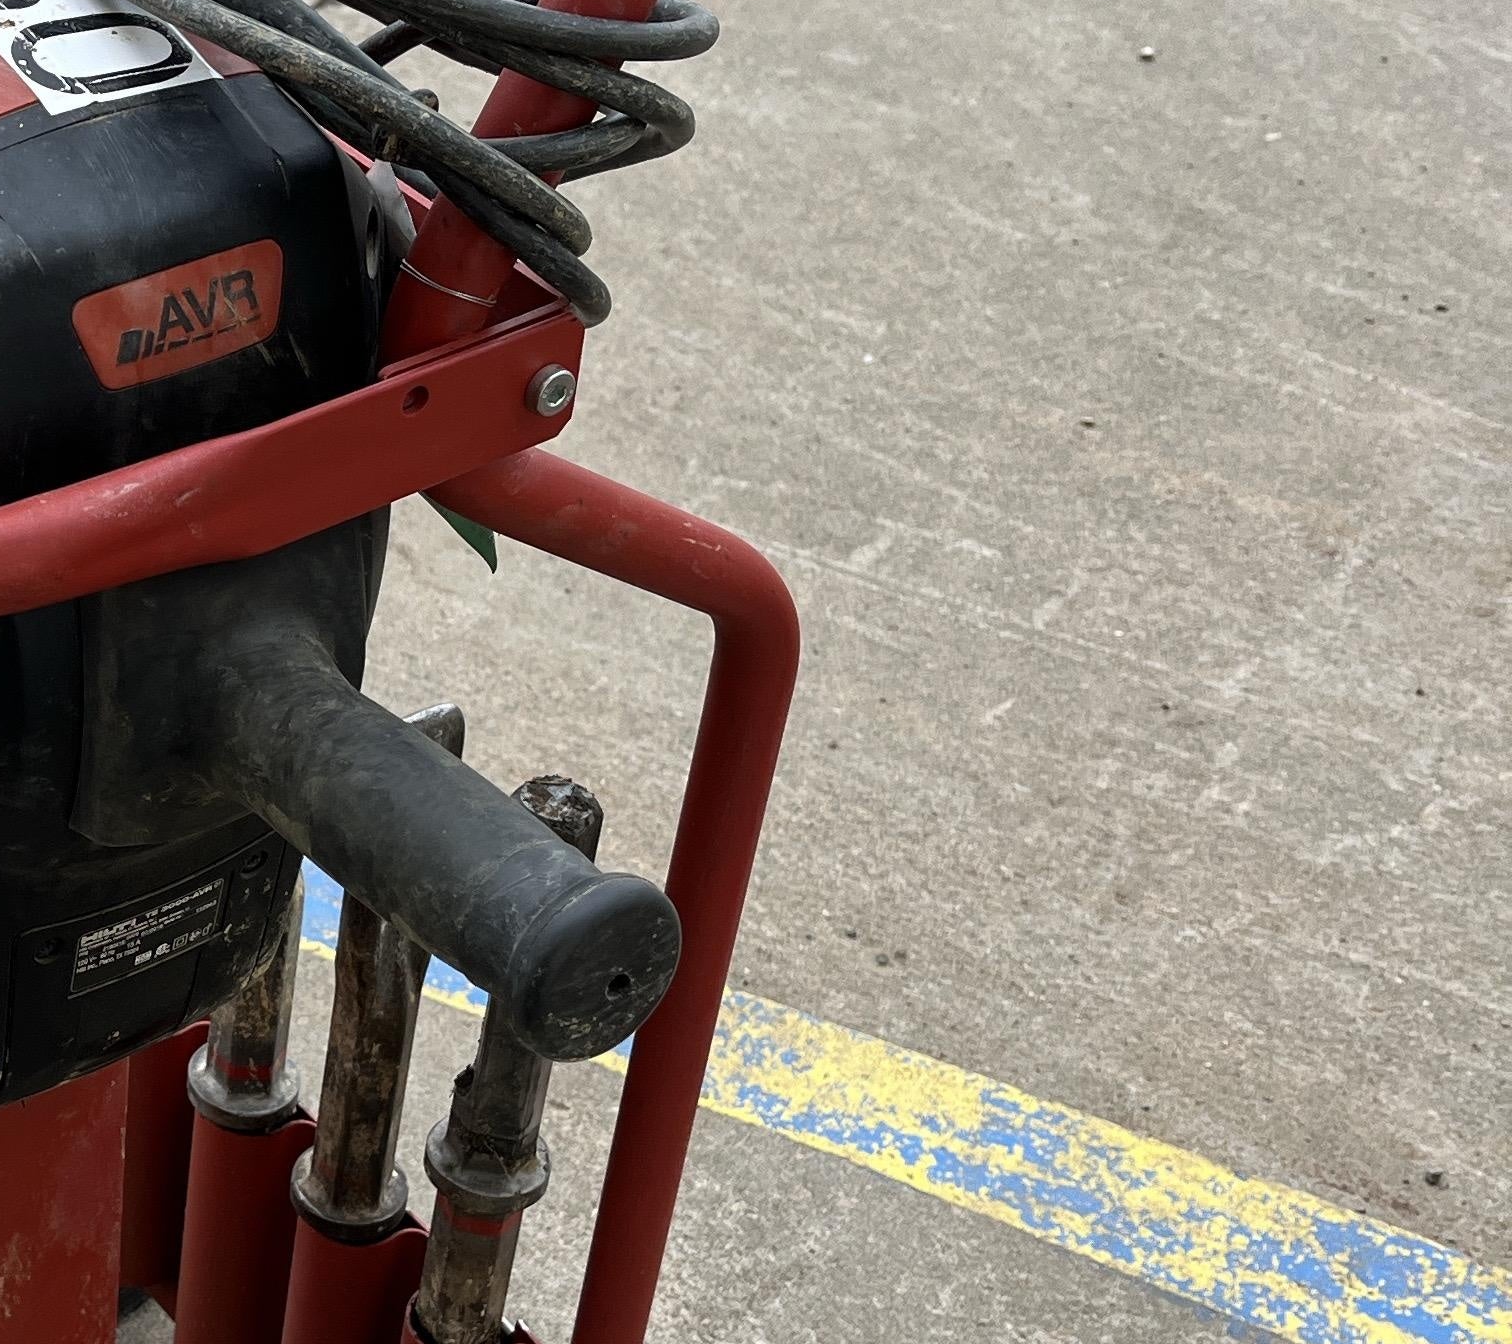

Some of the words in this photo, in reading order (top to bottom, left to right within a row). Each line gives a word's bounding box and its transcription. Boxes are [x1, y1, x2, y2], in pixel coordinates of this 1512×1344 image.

[157, 269, 261, 341] AVR
[80, 917, 137, 947] HILTI
[145, 908, 159, 919] TE
[160, 885, 213, 913] 3000-AVR
